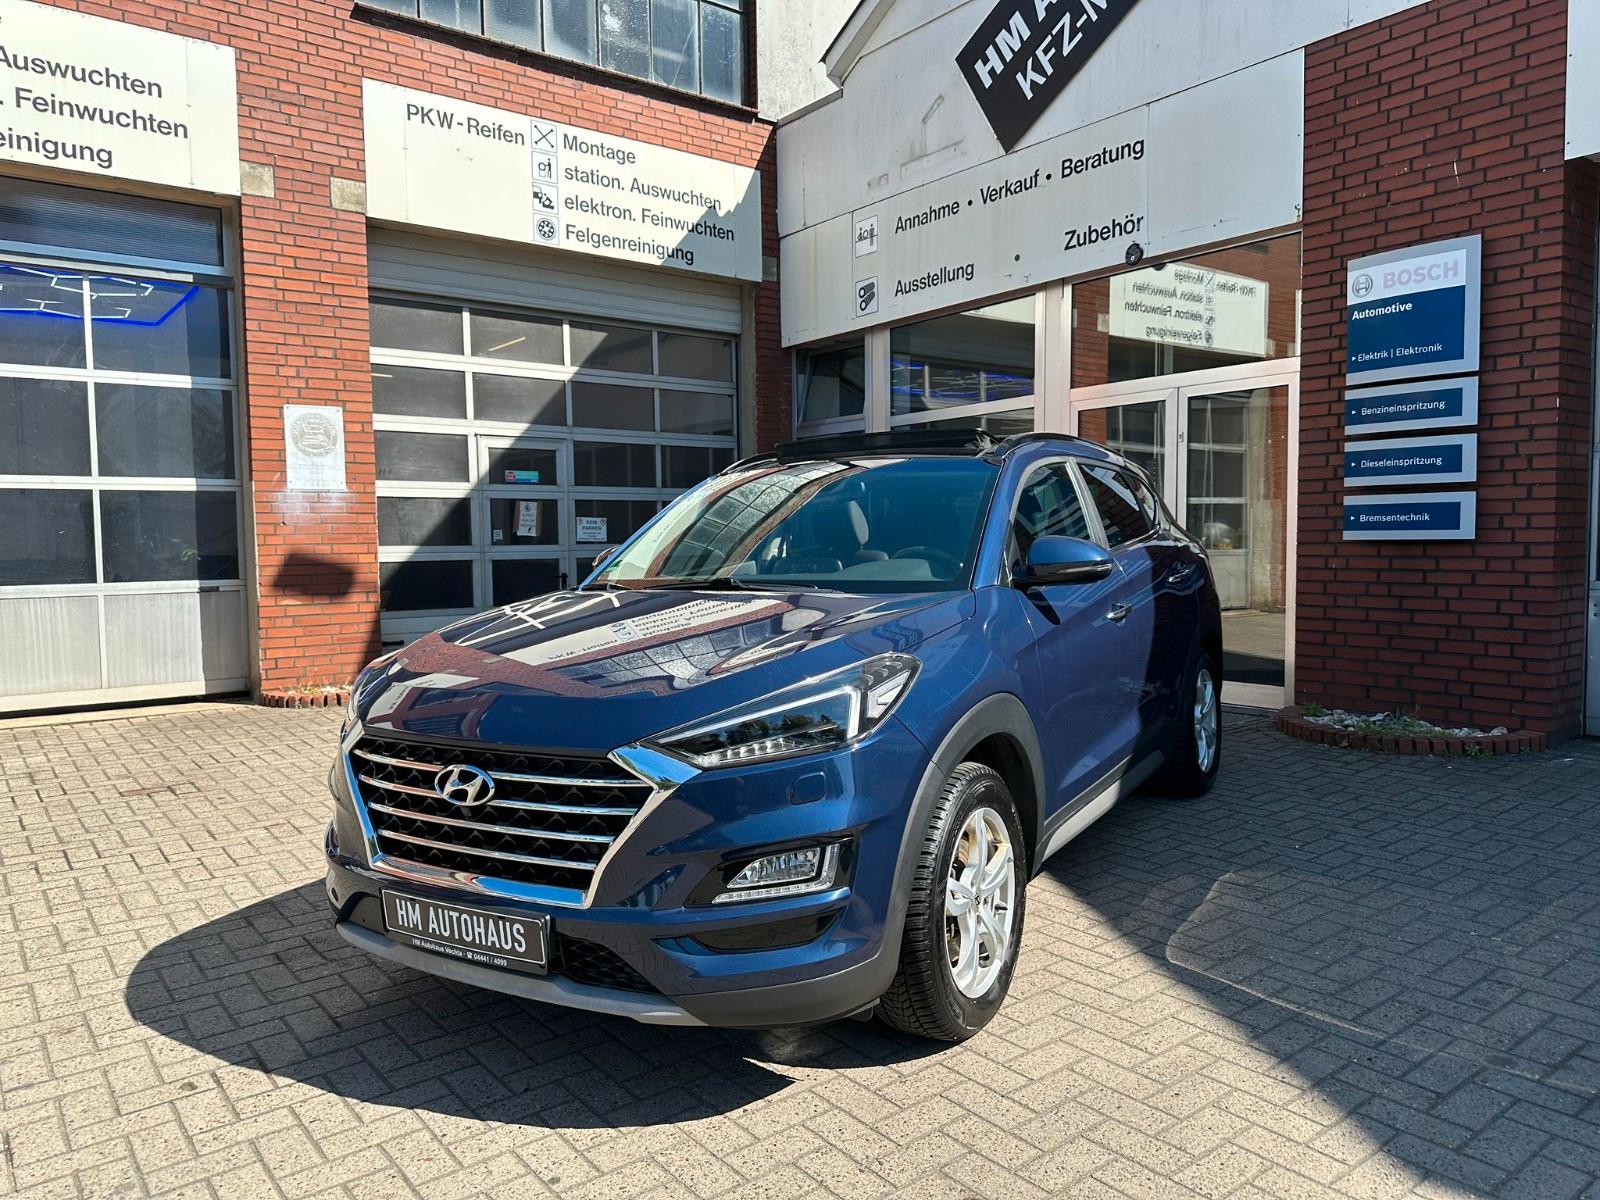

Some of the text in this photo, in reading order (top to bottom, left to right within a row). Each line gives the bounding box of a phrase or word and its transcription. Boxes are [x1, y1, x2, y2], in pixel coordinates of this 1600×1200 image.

[974, 10, 1031, 89] HM
[0, 45, 162, 98] Auswuchten
[15, 87, 188, 139] Feinwuchten
[406, 103, 525, 146] PKW-Reifen
[563, 133, 636, 165] Montage
[564, 166, 721, 211] station. Auswuchten
[895, 138, 1145, 234] Annahme Verkauf Beratung
[564, 195, 735, 241] elektron. Feinwuchten
[1064, 213, 1144, 251] Zubehör
[566, 224, 694, 265] Felgenreinigung
[894, 263, 975, 297] Ausstellung
[1383, 260, 1458, 289] BOSCH
[1352, 302, 1413, 320] Automotive
[1358, 343, 1442, 362] Elektrik Elektronik
[1361, 401, 1445, 416] Benzineinspritzung
[1360, 457, 1442, 468] Dieseleinspritzung
[1360, 513, 1430, 522] Bremsentechnik
[395, 899, 526, 953] HM AUTOHAUS
